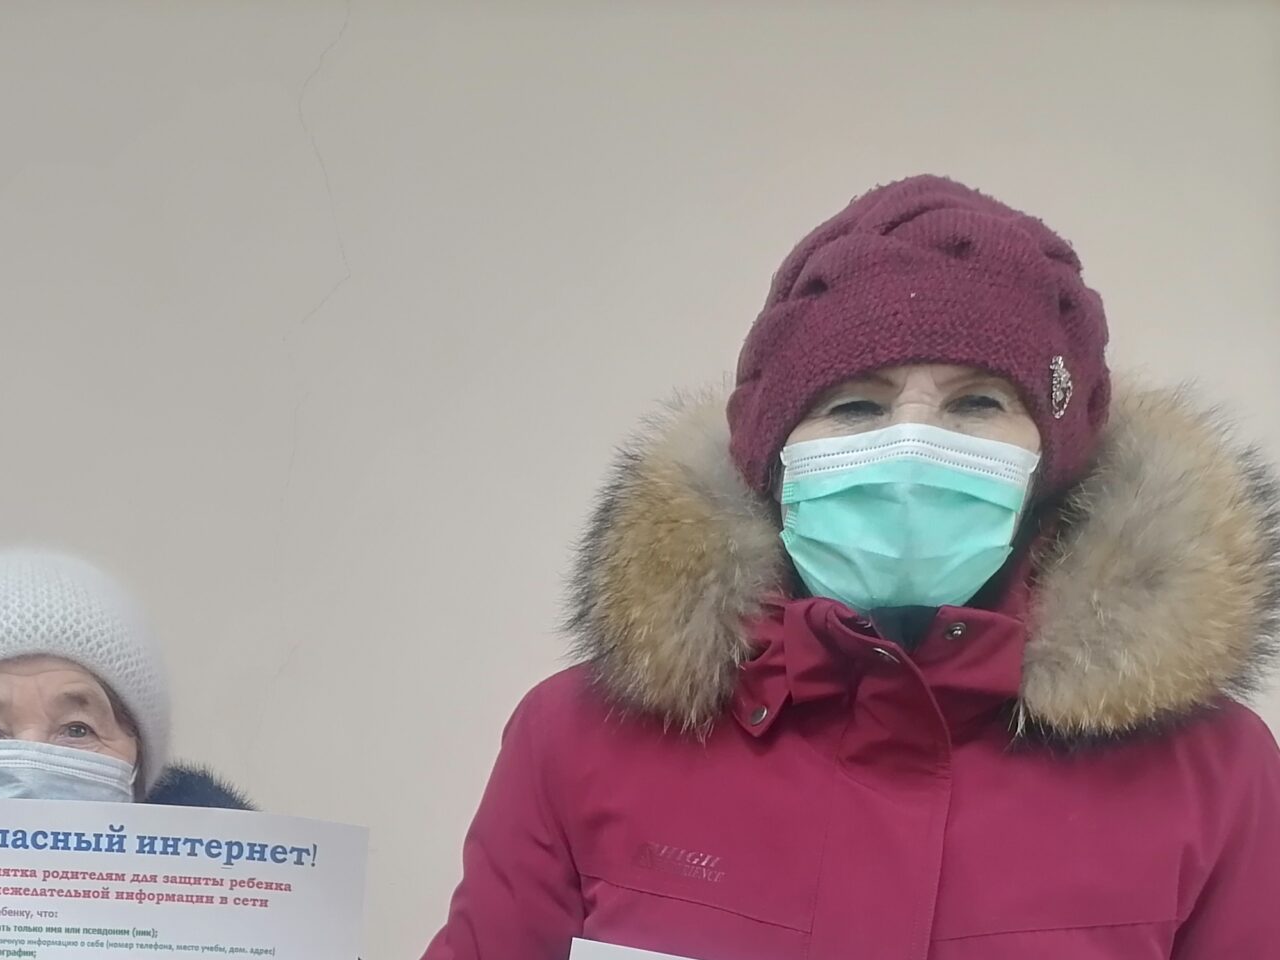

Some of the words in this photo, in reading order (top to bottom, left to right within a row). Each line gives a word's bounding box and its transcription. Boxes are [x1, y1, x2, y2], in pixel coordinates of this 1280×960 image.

[136, 834, 318, 867] интернет!
[42, 868, 125, 882] родителям
[130, 871, 157, 884] для
[162, 873, 223, 886] защиты
[229, 876, 291, 891] ребенка
[115, 888, 213, 905] информации
[219, 894, 227, 905] в
[233, 895, 268, 907] сети
[36, 910, 57, 918] что:
[13, 924, 43, 933] только
[44, 925, 62, 933] имя
[64, 925, 80, 934] или
[82, 926, 129, 936] псевдоним
